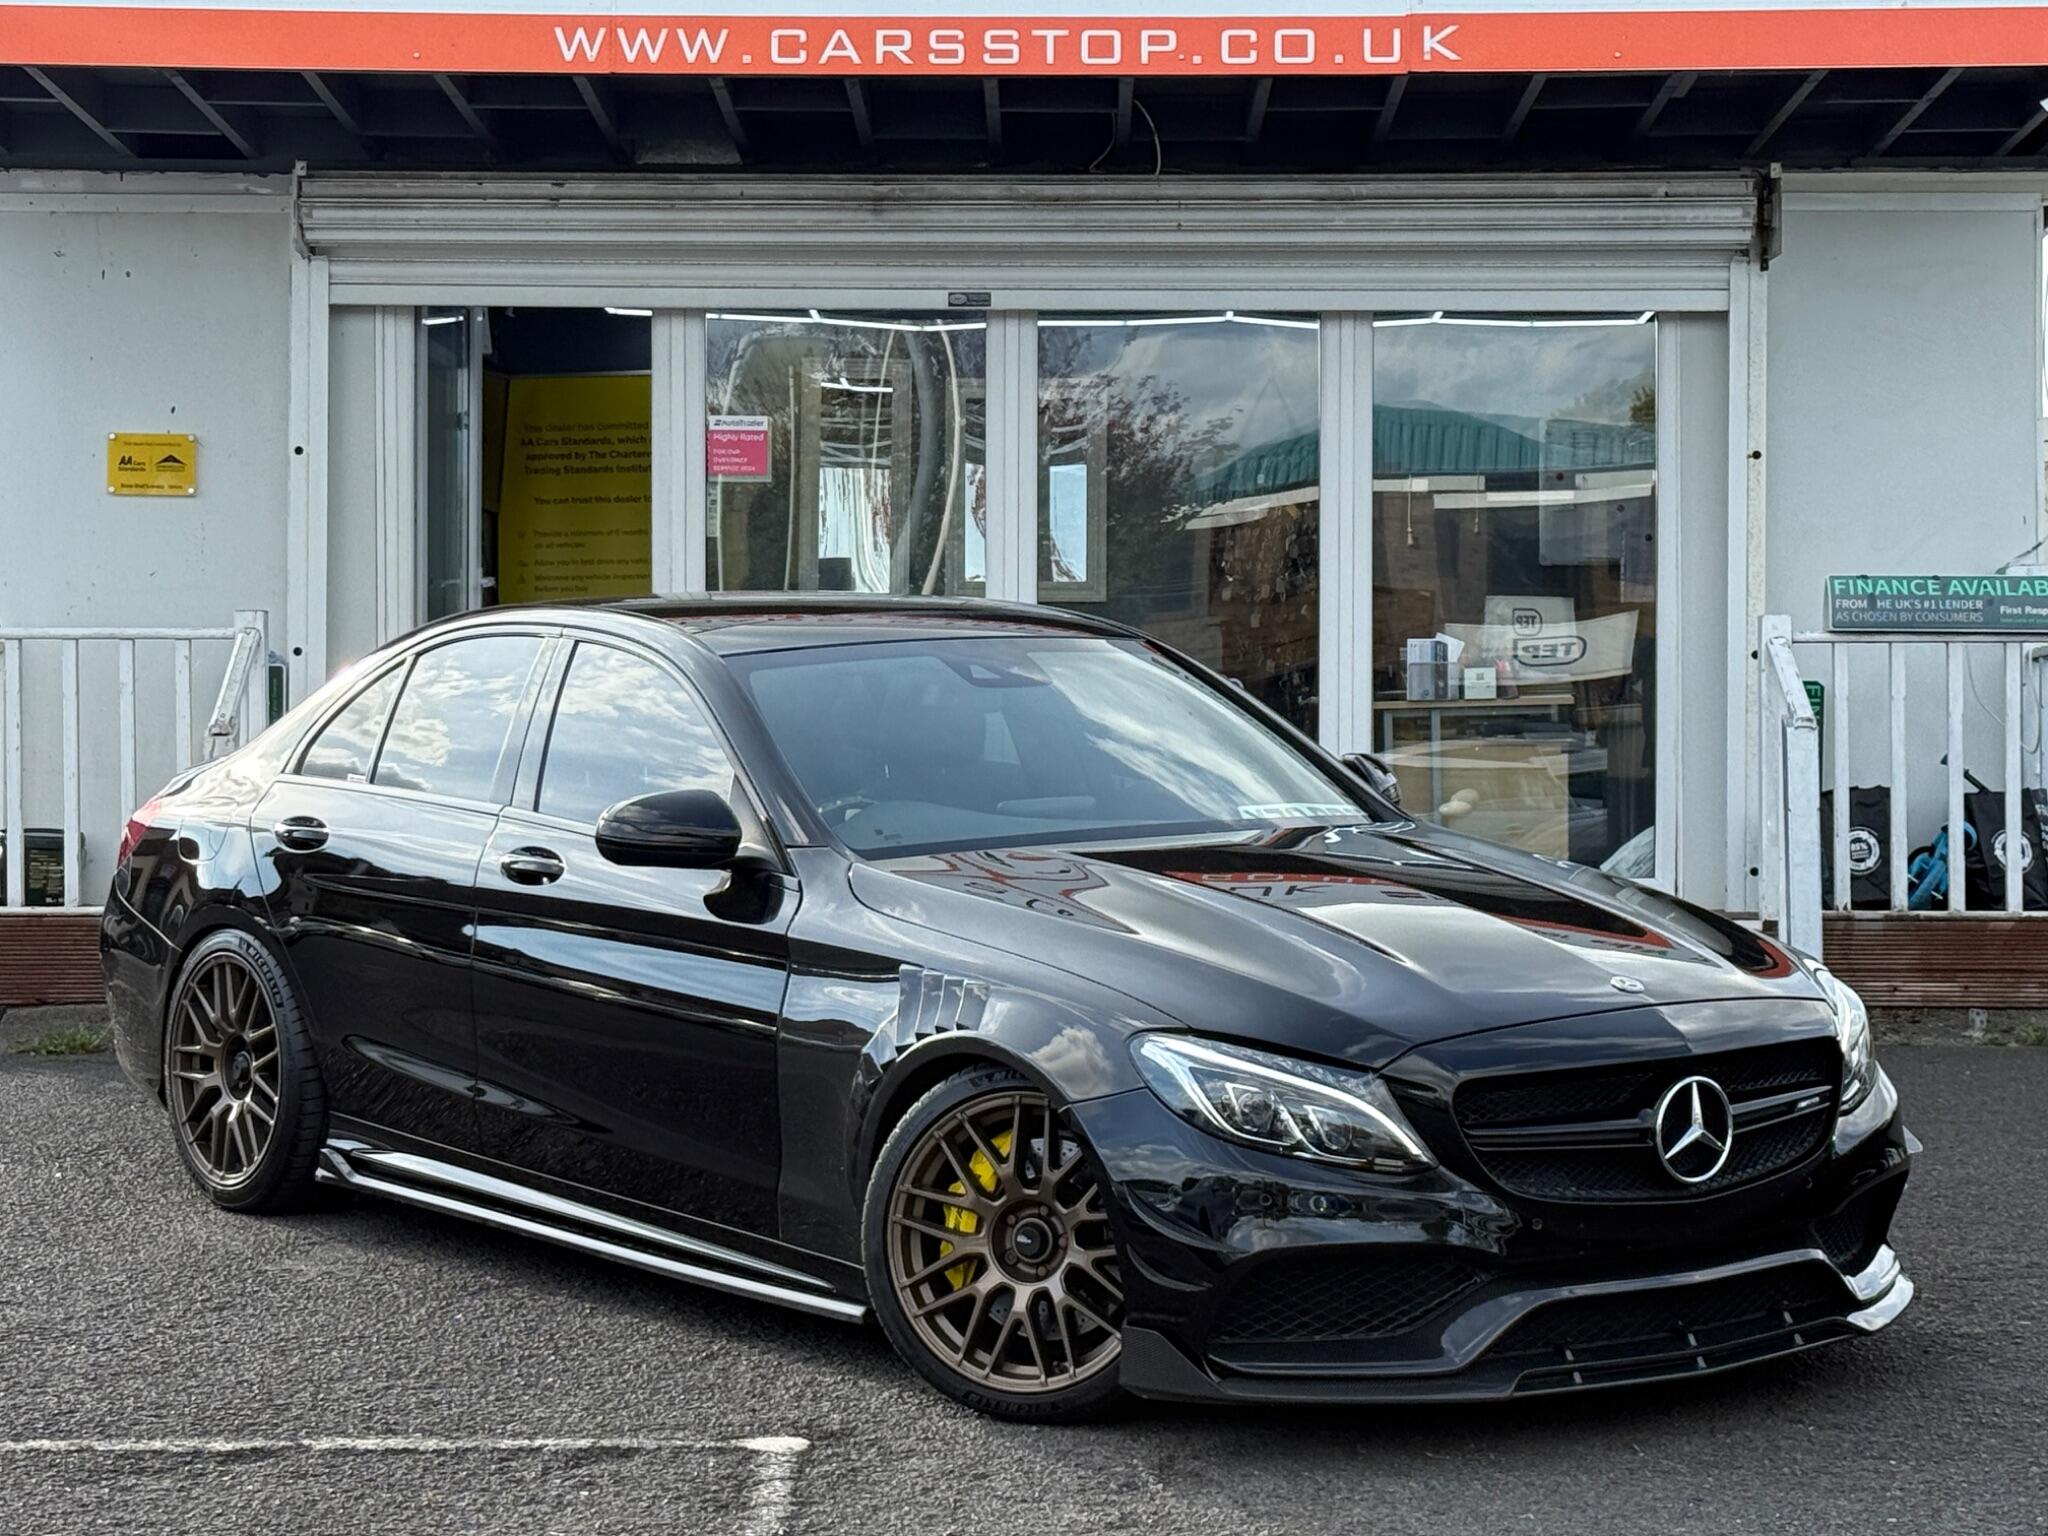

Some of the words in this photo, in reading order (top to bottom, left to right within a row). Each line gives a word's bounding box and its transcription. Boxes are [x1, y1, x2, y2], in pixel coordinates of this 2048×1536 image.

[555, 25, 1461, 65] WWW.CARSSTOP.CO.UK
[617, 434, 646, 444] which
[740, 433, 764, 441] Rated
[526, 451, 572, 462] approved
[575, 451, 587, 461] by
[588, 450, 606, 459] The
[563, 464, 614, 474] Standards
[1834, 579, 1941, 596] FINANCE
[1948, 579, 2048, 597] AVAILAB
[1835, 599, 1868, 609] FROM
[1895, 599, 1921, 609] UK'S
[1923, 600, 1936, 609] #1
[1939, 600, 1984, 610] LENDER
[2000, 605, 2021, 615] First
[1835, 611, 1849, 622] AS
[1852, 611, 1897, 622] CHOSEN
[1901, 611, 1914, 622] BY
[1915, 611, 1984, 622] CONSUMERS
[246, 943, 284, 1008] MICHELIN
